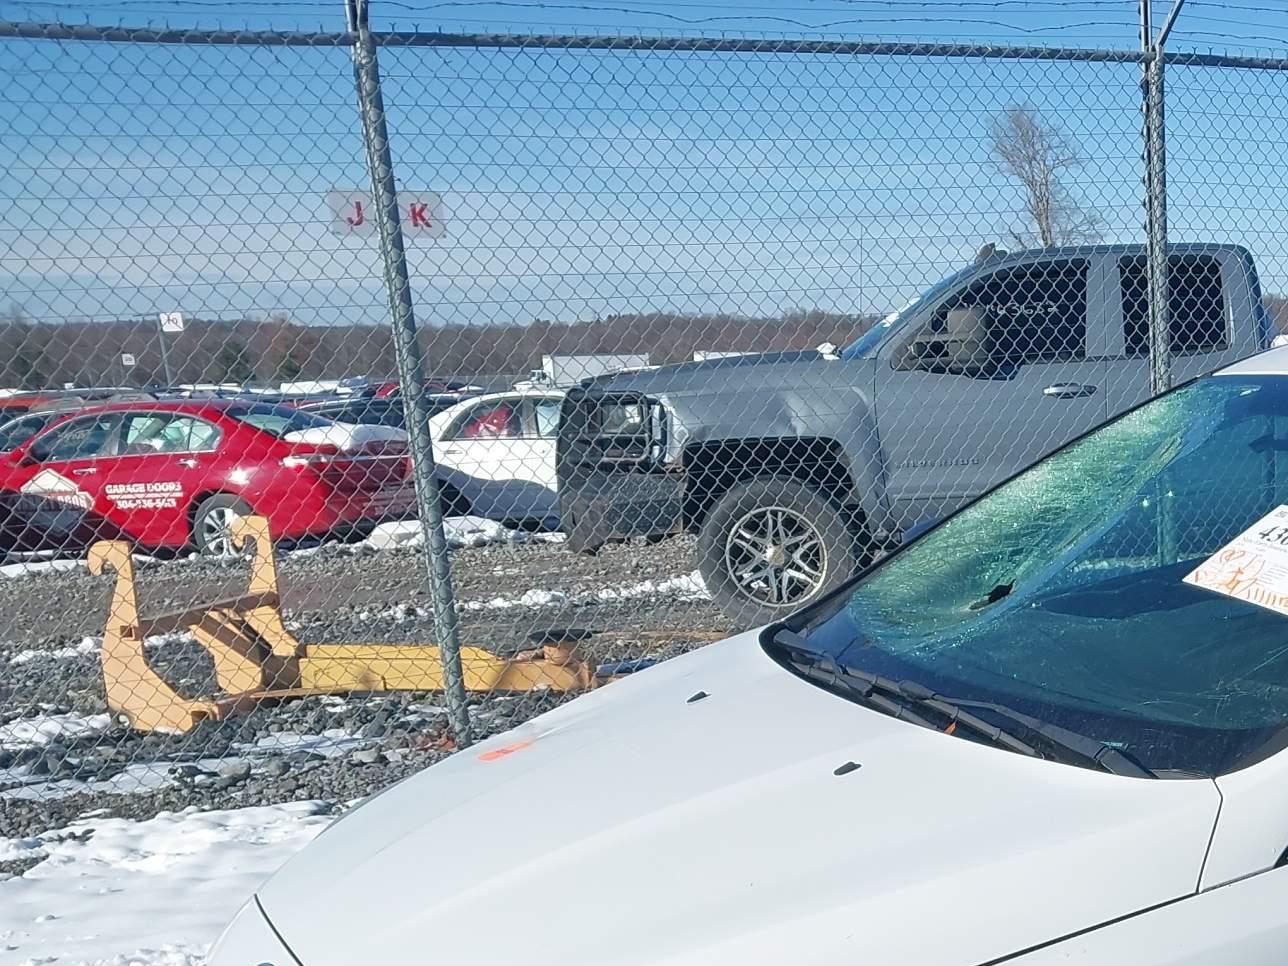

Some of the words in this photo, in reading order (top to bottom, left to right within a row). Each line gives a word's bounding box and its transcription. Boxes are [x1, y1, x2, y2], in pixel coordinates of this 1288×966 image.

[347, 201, 363, 226] J
[409, 203, 432, 228] K
[105, 483, 145, 495] GARAGE
[146, 481, 182, 492] DOORS
